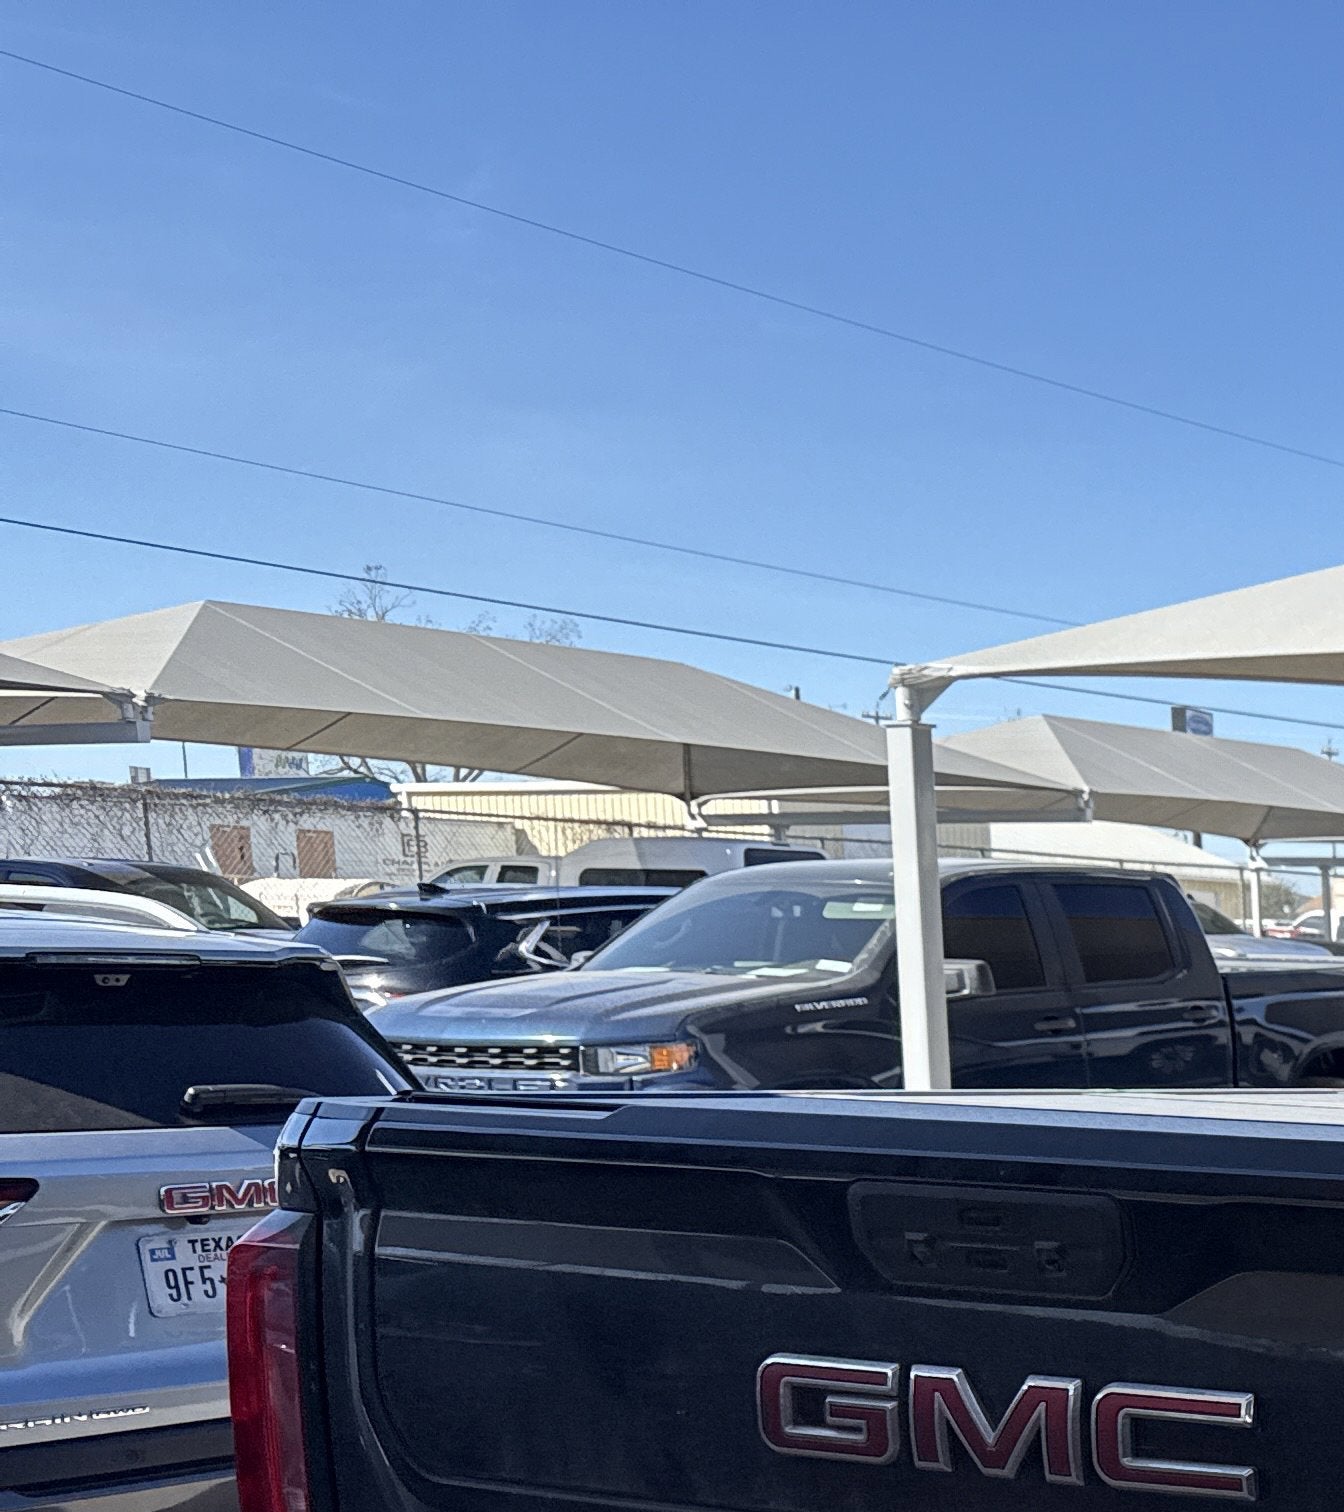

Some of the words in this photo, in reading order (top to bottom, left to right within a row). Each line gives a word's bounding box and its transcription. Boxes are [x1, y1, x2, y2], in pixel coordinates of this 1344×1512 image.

[187, 1236, 241, 1254] TEXA
[197, 1252, 228, 1263] DEAL
[755, 1352, 1257, 1500] GMC
